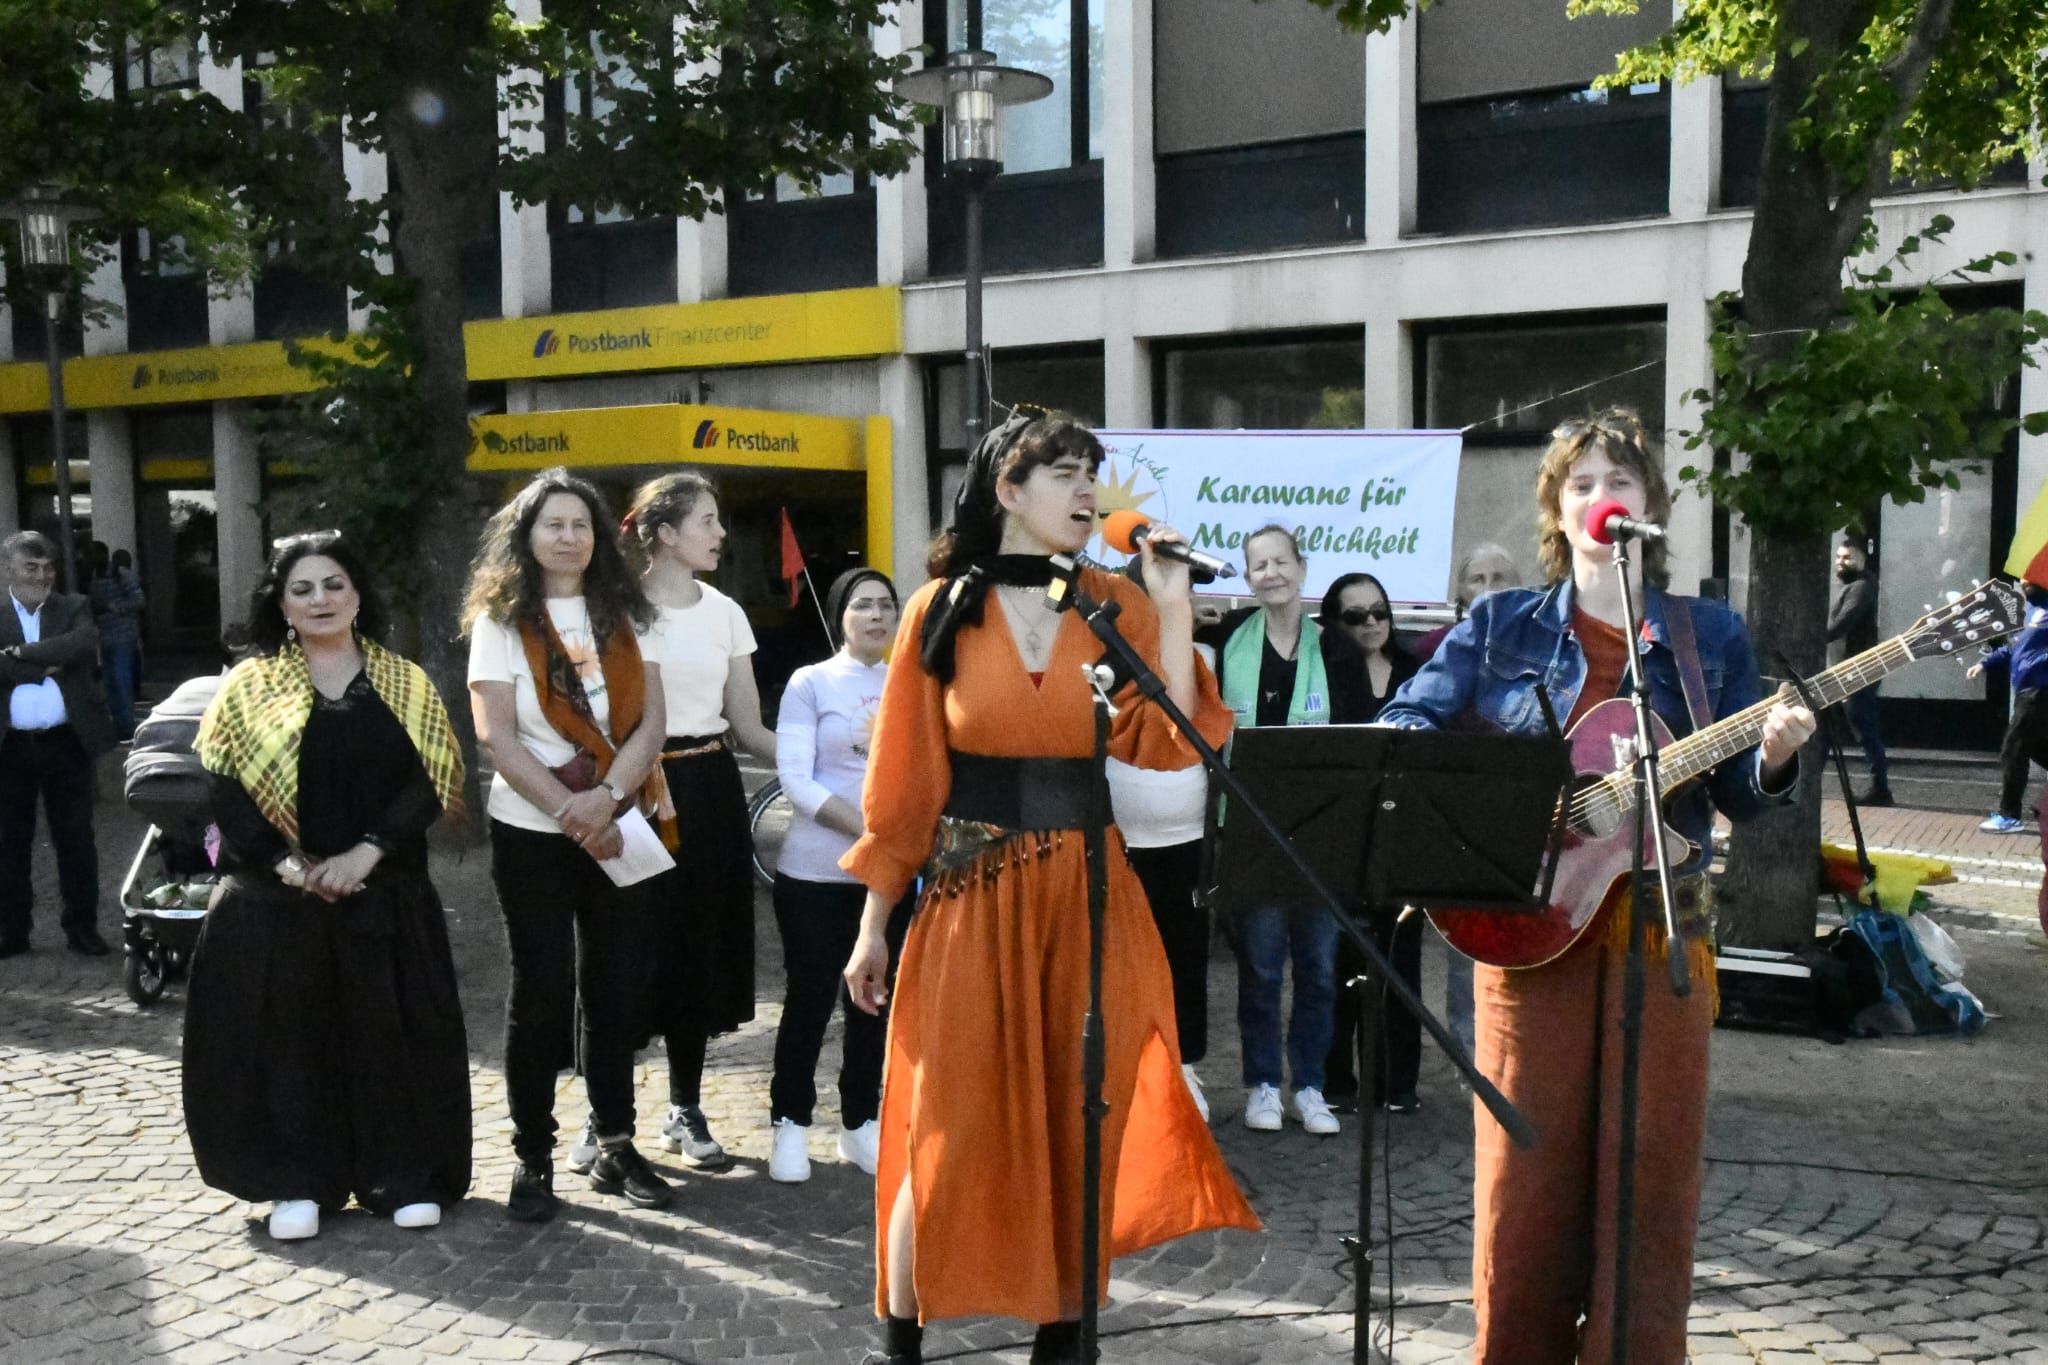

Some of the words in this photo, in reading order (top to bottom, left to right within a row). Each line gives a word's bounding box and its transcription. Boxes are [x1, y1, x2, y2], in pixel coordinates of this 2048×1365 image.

[568, 328, 652, 353] Postbank
[656, 322, 772, 346] Finanzcenter
[158, 365, 220, 385] Postbank
[487, 430, 570, 454] ostbank
[727, 428, 800, 453] Postbank
[1196, 476, 1351, 506] Karawane
[1360, 477, 1406, 512] für
[1188, 523, 1419, 560] Mehlichkeit
